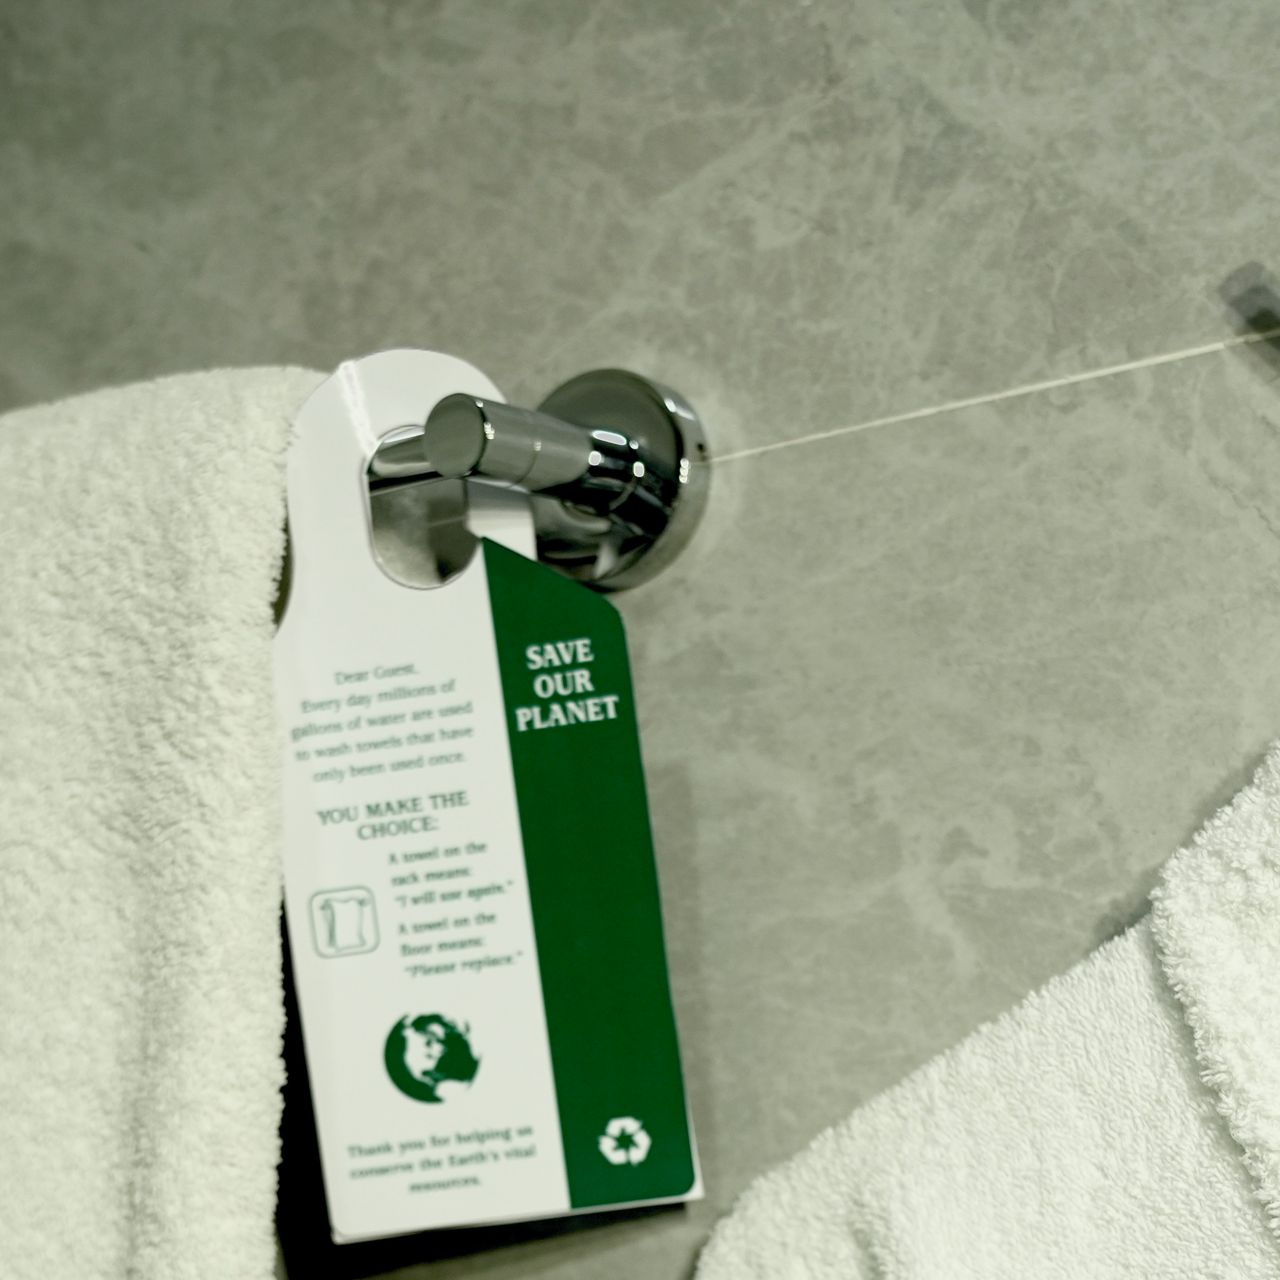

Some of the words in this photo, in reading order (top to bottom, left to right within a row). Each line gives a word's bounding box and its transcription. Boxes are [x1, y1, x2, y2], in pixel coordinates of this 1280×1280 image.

[525, 637, 594, 670] SAVE
[335, 671, 369, 685] Dear
[533, 668, 595, 698] OUR
[301, 699, 341, 713] Every
[346, 693, 371, 708] day
[377, 684, 436, 701] millions
[440, 678, 456, 693] of
[291, 721, 343, 742] gallons
[347, 716, 362, 730] of
[366, 713, 406, 727] water
[411, 709, 433, 721] are
[438, 701, 473, 717] used
[515, 694, 619, 732] PLANET
[295, 750, 310, 761] to
[315, 743, 351, 757] wash
[355, 736, 403, 752] towels
[406, 732, 435, 745] that
[438, 727, 474, 740] have
[313, 767, 345, 783] only
[349, 763, 385, 777] been
[390, 756, 424, 771] used
[428, 752, 465, 765] once.
[316, 806, 359, 825] YOU
[365, 797, 423, 818] MAKE
[429, 791, 470, 809] THE
[356, 816, 440, 840] CHOICE:
[388, 853, 398, 865] A
[402, 847, 439, 863] towel
[443, 846, 461, 857] on
[465, 842, 487, 854] the
[392, 872, 419, 886] rack
[411, 891, 436, 905] will
[439, 889, 463, 901] use
[398, 923, 408, 935] A
[412, 917, 449, 933] towel
[453, 916, 470, 928] on
[474, 912, 496, 925] the
[400, 942, 433, 957] floor
[347, 1142, 393, 1157] Thank
[398, 1140, 426, 1155] you
[430, 1136, 450, 1147] for
[455, 1127, 512, 1144] helping
[516, 1126, 534, 1136] us
[350, 1162, 414, 1179] conserve
[420, 1158, 443, 1171] the
[448, 1151, 500, 1167] Earth's
[504, 1145, 537, 1160] vital
[409, 1176, 481, 1193] resources.
